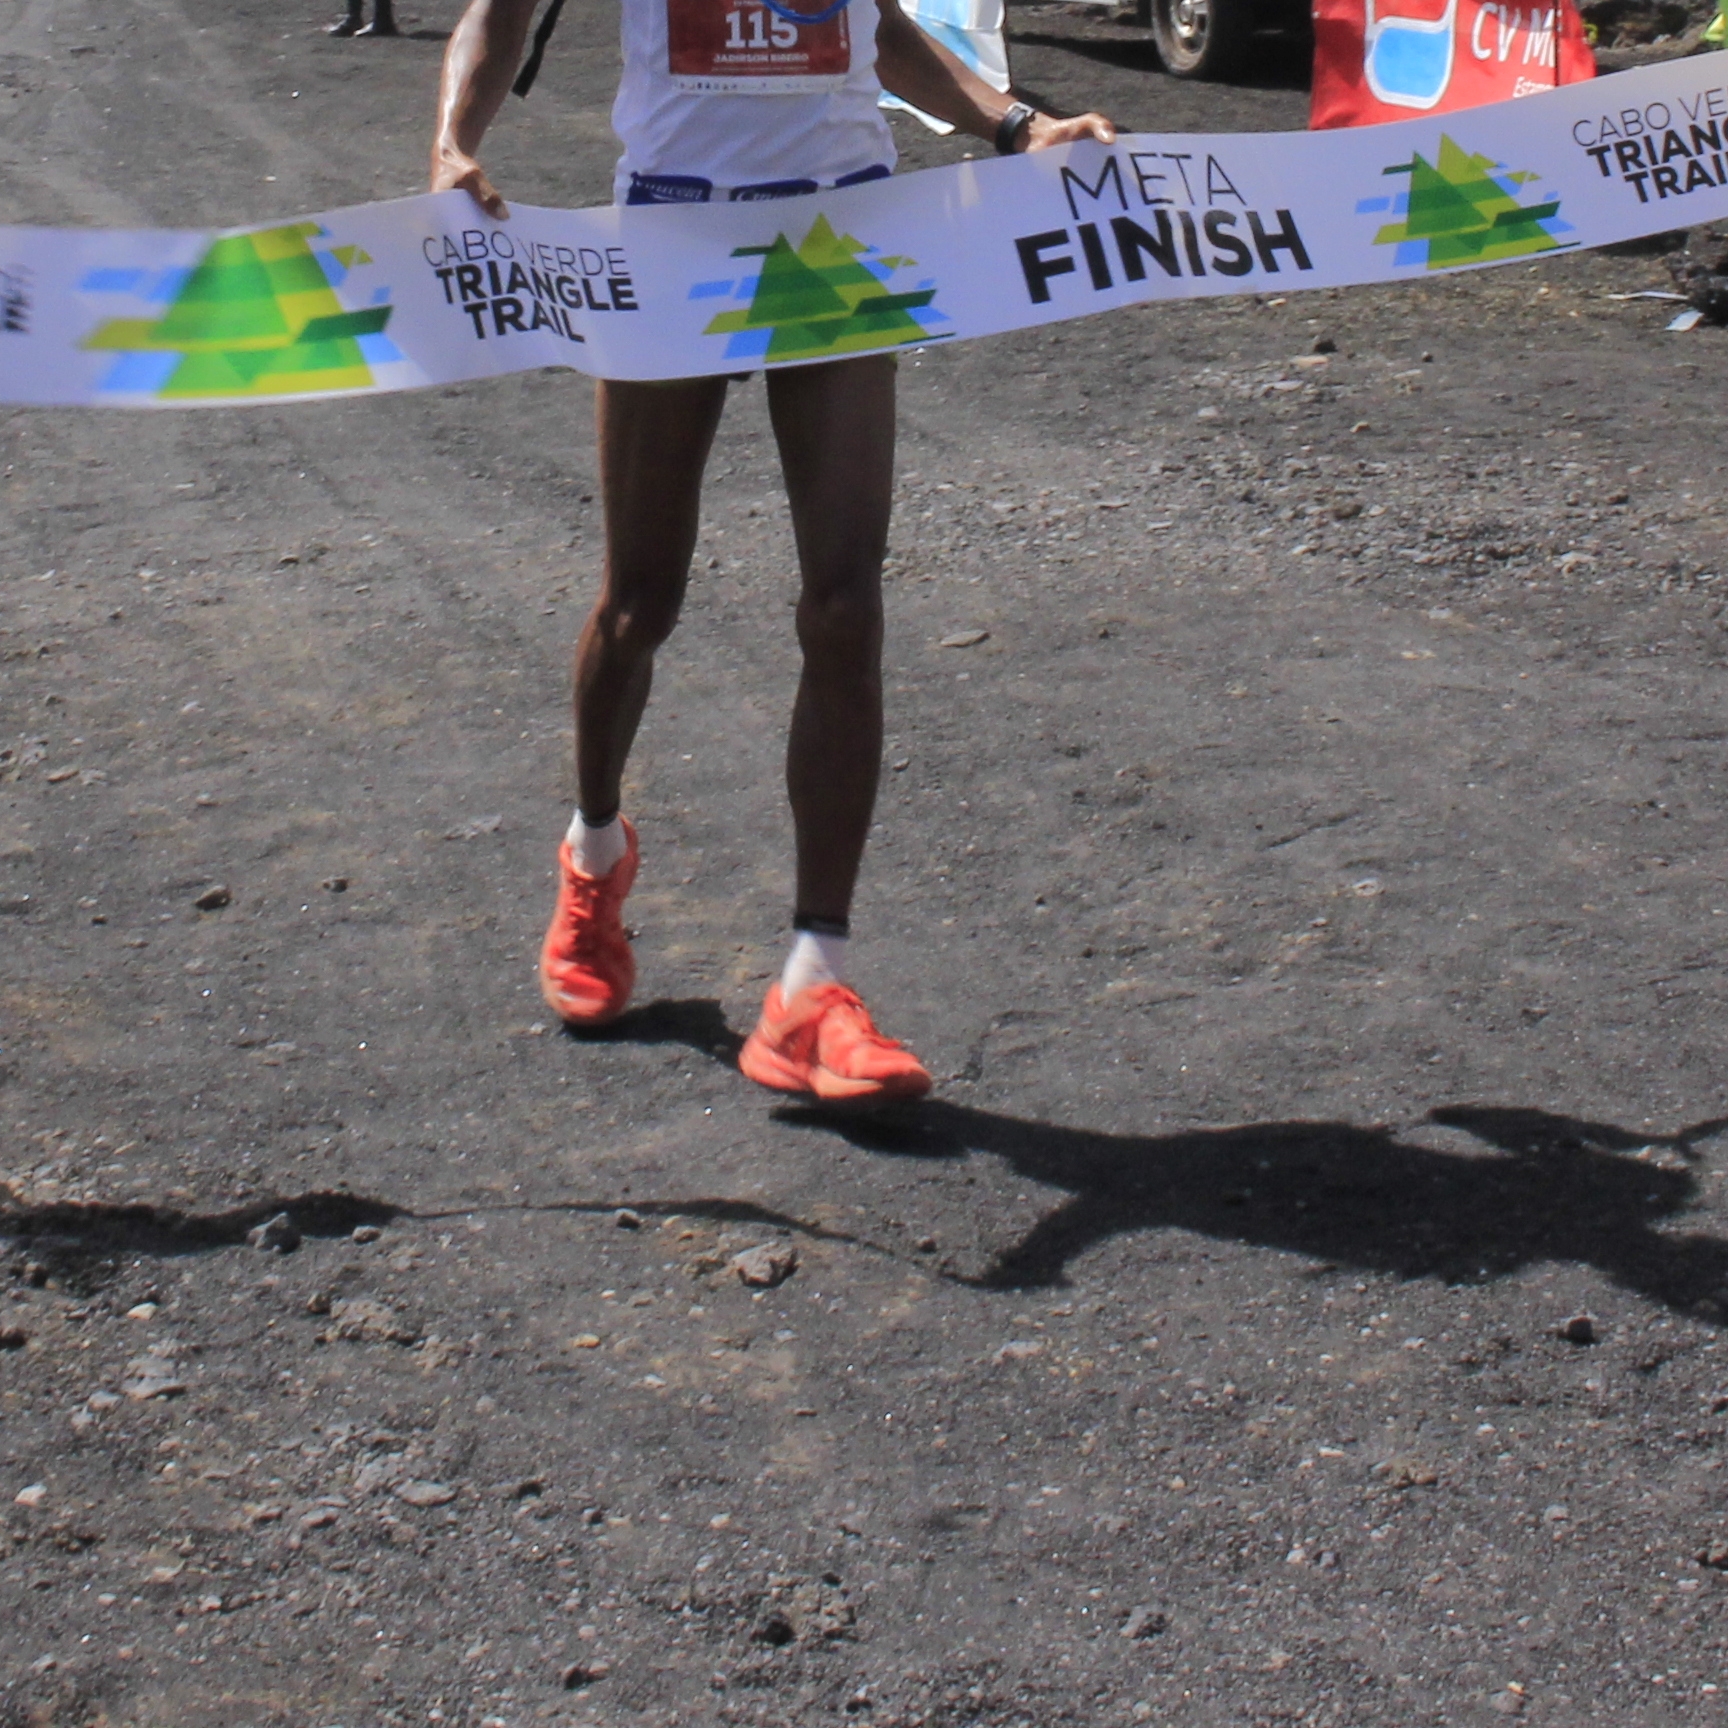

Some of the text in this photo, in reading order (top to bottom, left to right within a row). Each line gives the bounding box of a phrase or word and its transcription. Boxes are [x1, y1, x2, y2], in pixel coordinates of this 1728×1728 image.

[725, 10, 799, 49] 115
[1471, 2, 1522, 63] CV
[1572, 102, 1672, 148] CABO
[1060, 152, 1248, 221] META
[422, 230, 631, 277] CABO VERDE
[1014, 209, 1314, 305] FINISH
[435, 260, 639, 312] TRIANGLE
[464, 296, 586, 344] TRAIL
